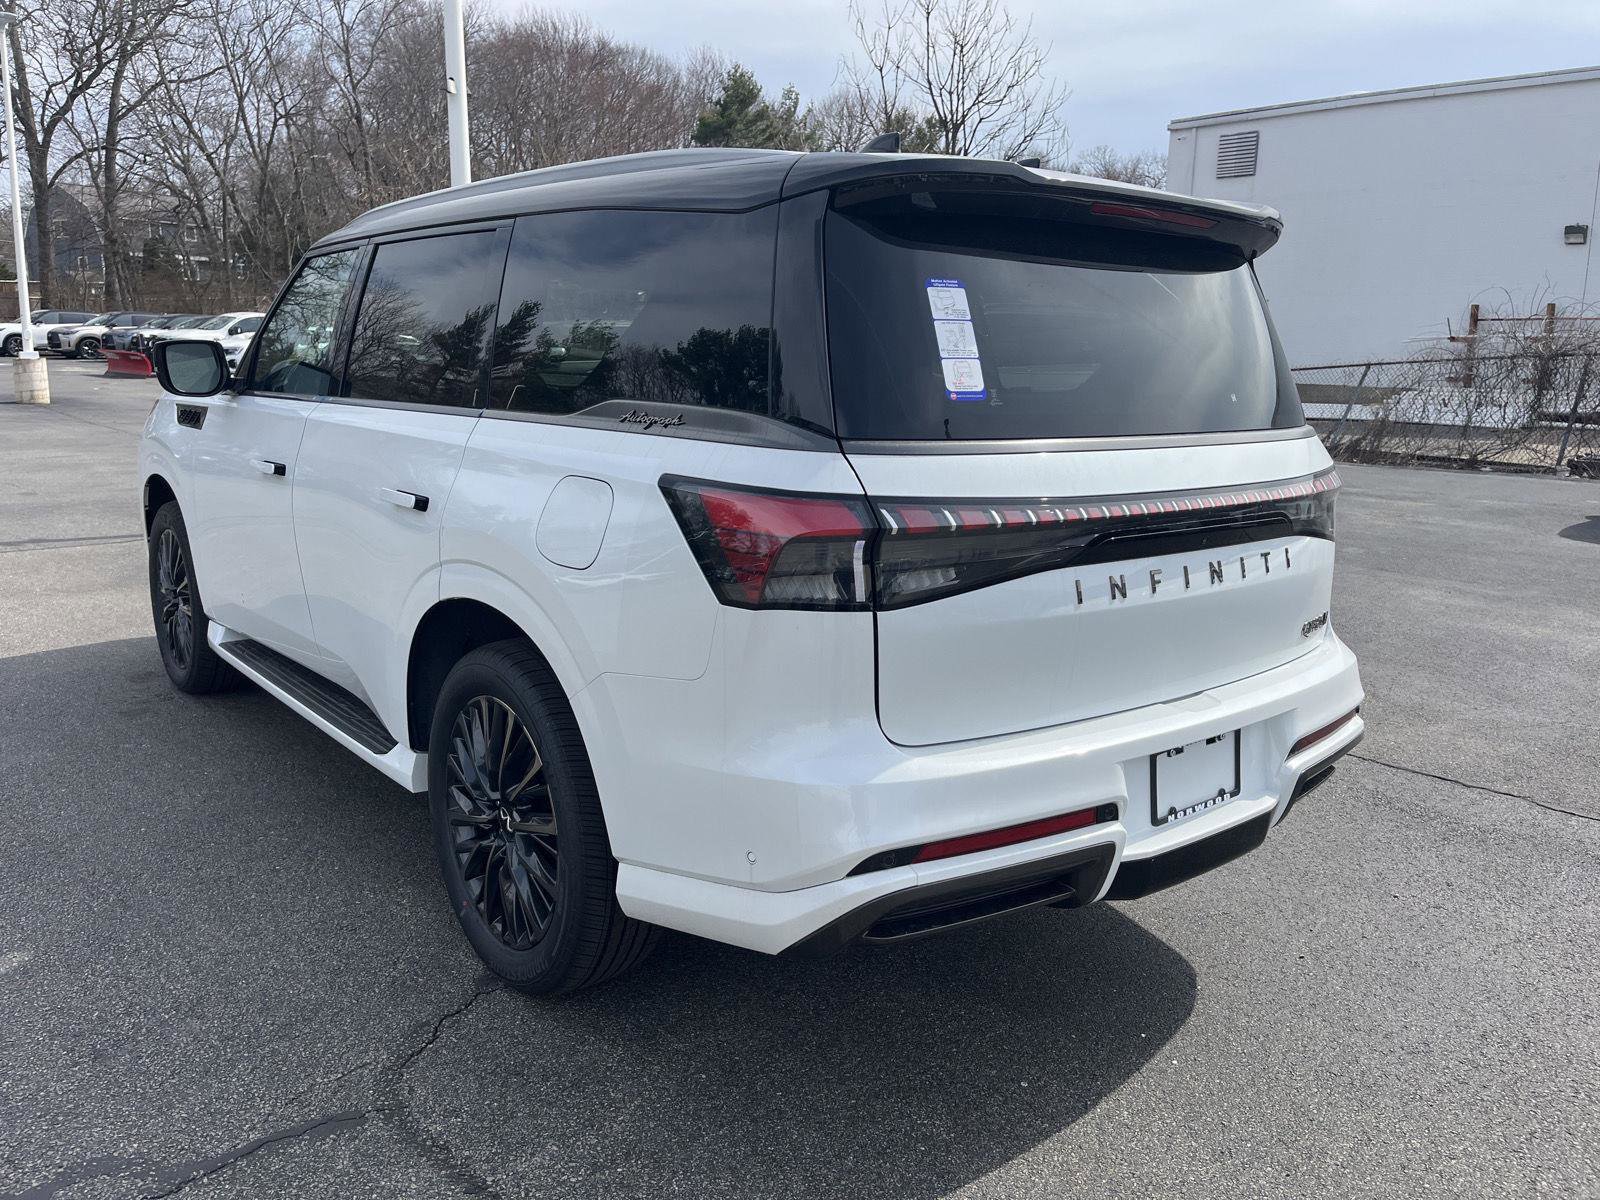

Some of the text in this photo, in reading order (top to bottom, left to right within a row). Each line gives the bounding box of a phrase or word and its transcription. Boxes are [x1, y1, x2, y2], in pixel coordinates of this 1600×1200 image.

[619, 409, 686, 430] Autograph
[1074, 547, 1291, 605] INFINITI
[1167, 793, 1231, 823] NORWOOD
